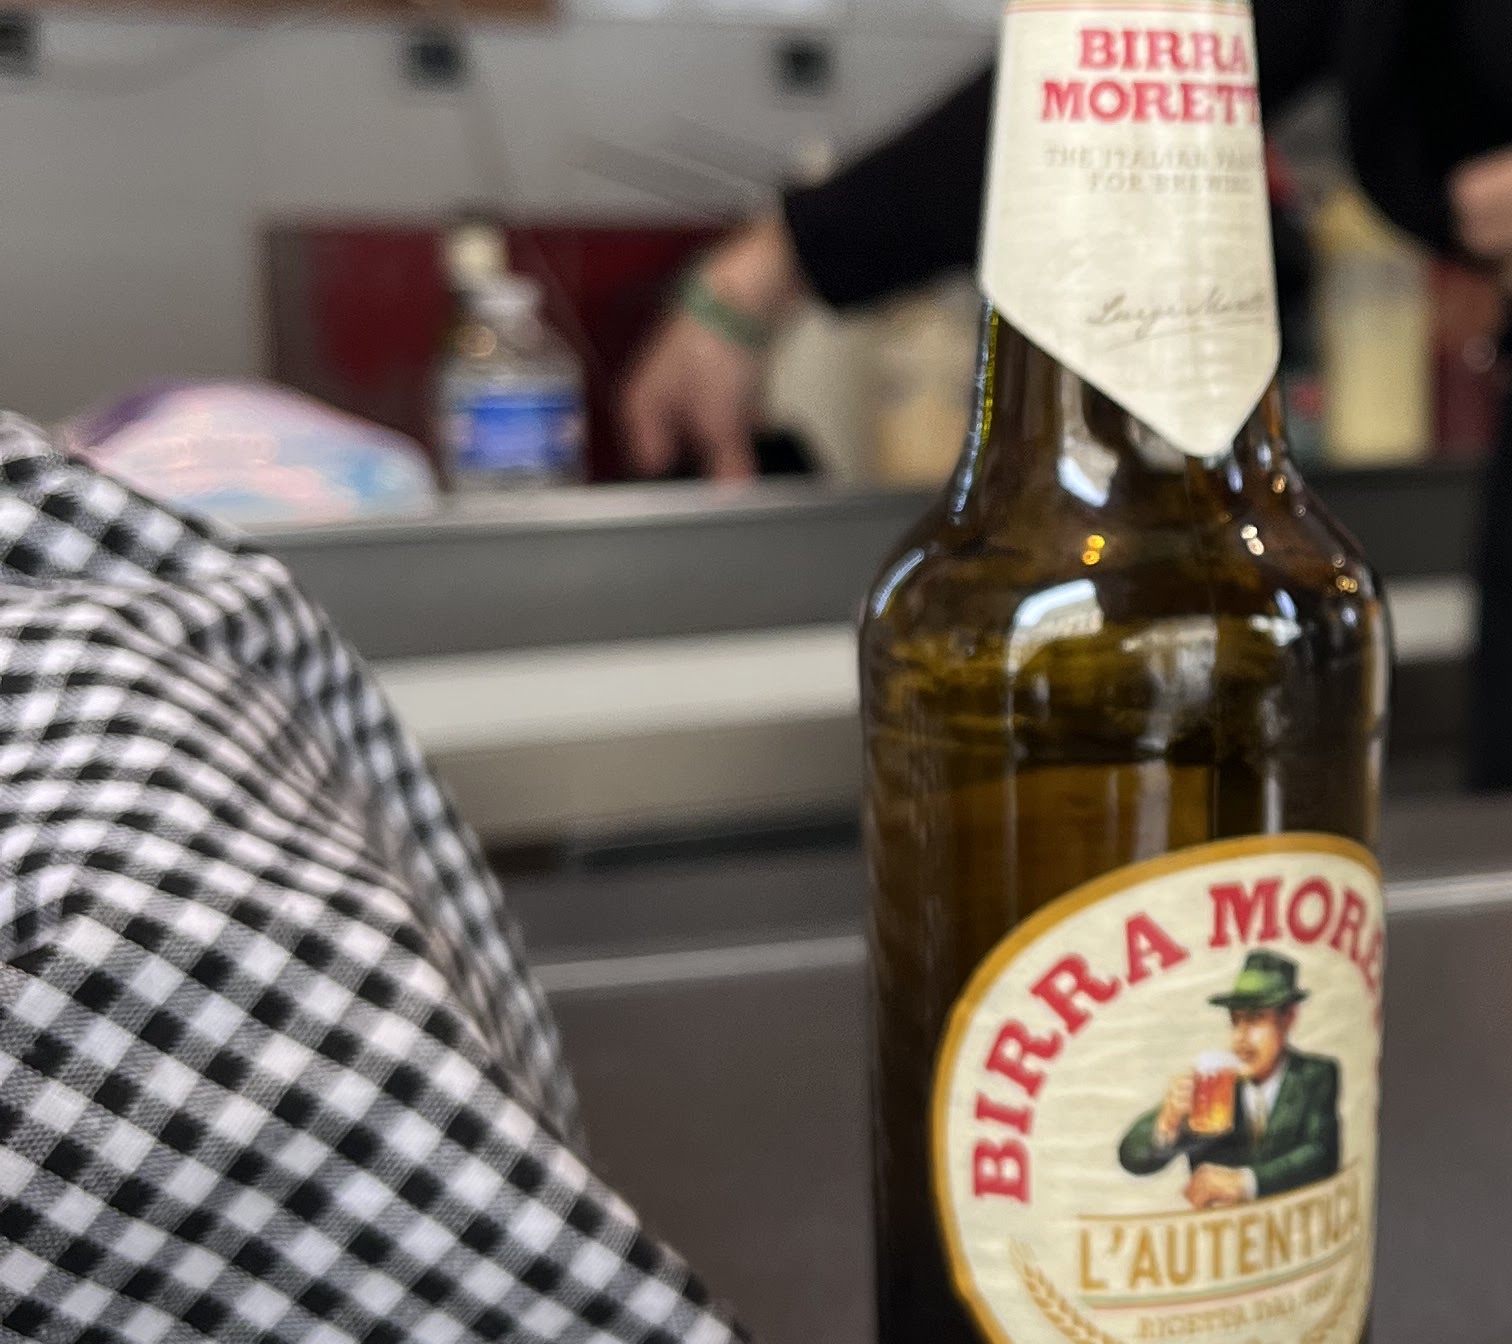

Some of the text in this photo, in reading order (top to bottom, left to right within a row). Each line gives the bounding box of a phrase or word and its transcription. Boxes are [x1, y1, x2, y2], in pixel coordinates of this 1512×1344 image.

[1078, 30, 1248, 73] BIRRA
[972, 876, 1383, 1205] BIRRA MORE
